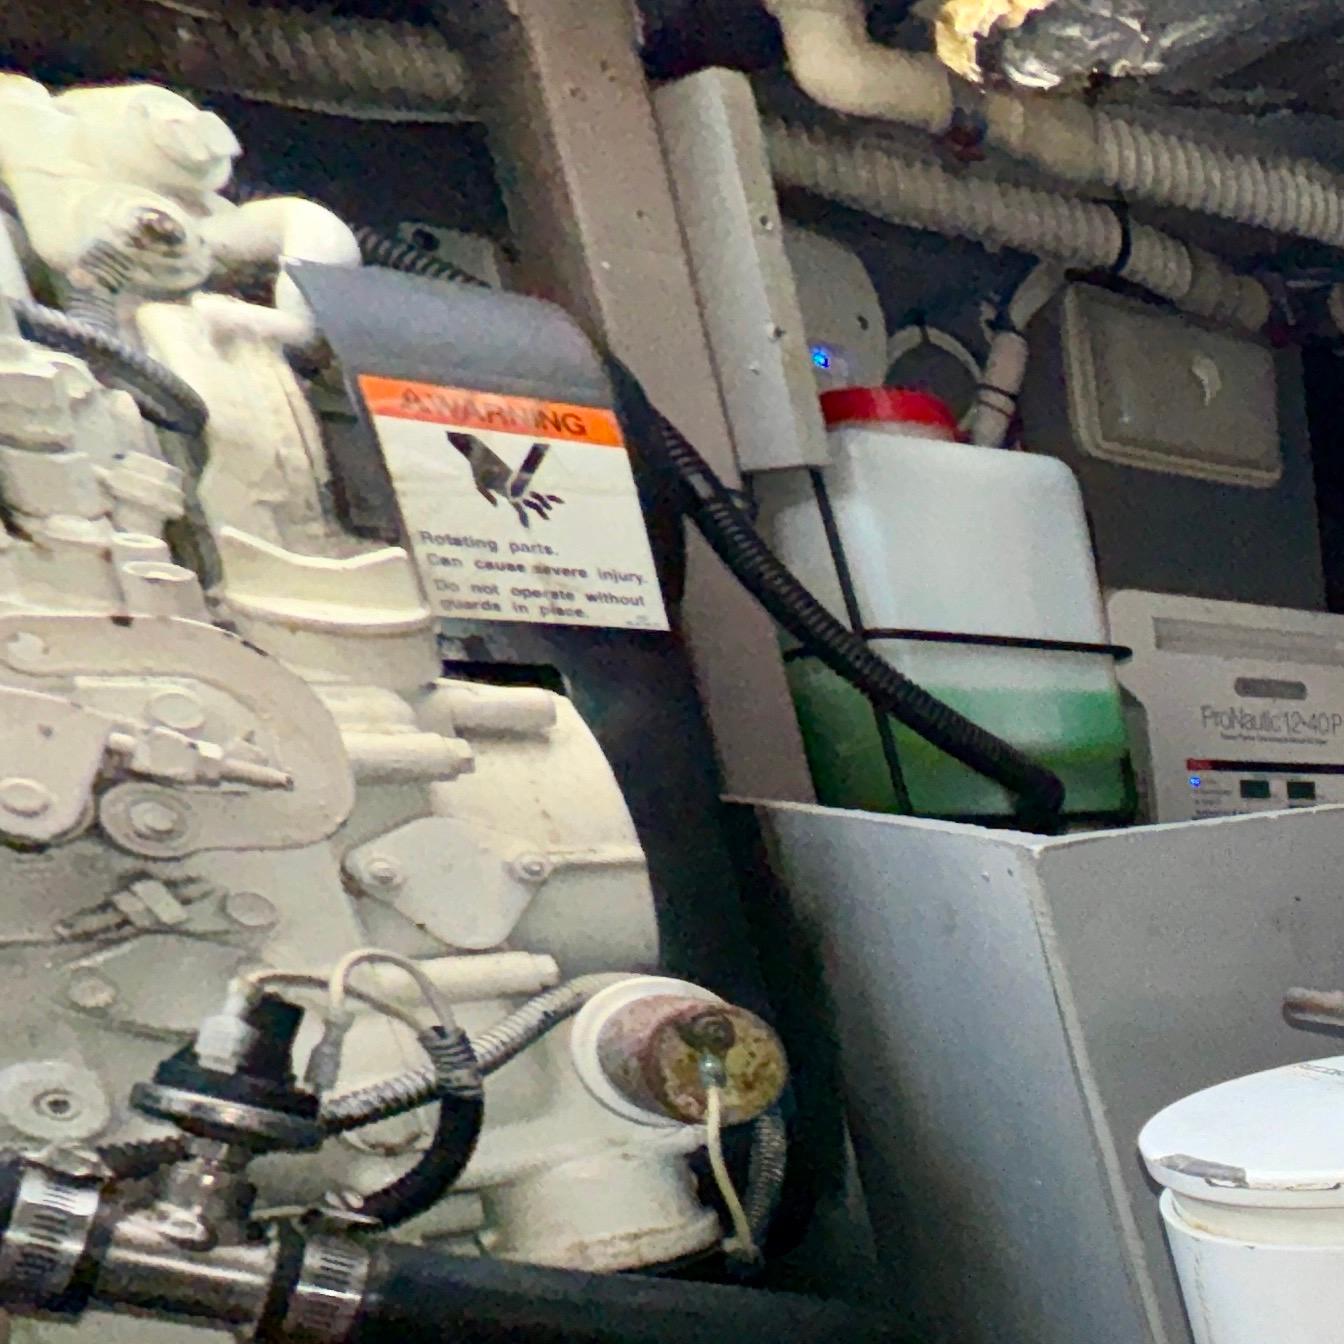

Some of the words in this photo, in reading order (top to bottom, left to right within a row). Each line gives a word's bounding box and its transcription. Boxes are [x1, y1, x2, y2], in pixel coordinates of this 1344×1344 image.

[420, 531, 498, 553] Rotating
[509, 539, 558, 556] parts.
[427, 553, 463, 568] Can
[474, 558, 526, 573] cause
[532, 562, 588, 578] severe
[597, 567, 648, 585] injury.
[433, 578, 460, 593] Do
[470, 581, 499, 595] not
[510, 586, 575, 601] operate
[585, 591, 645, 606] without
[512, 602, 528, 614] in
[539, 603, 589, 618] place.
